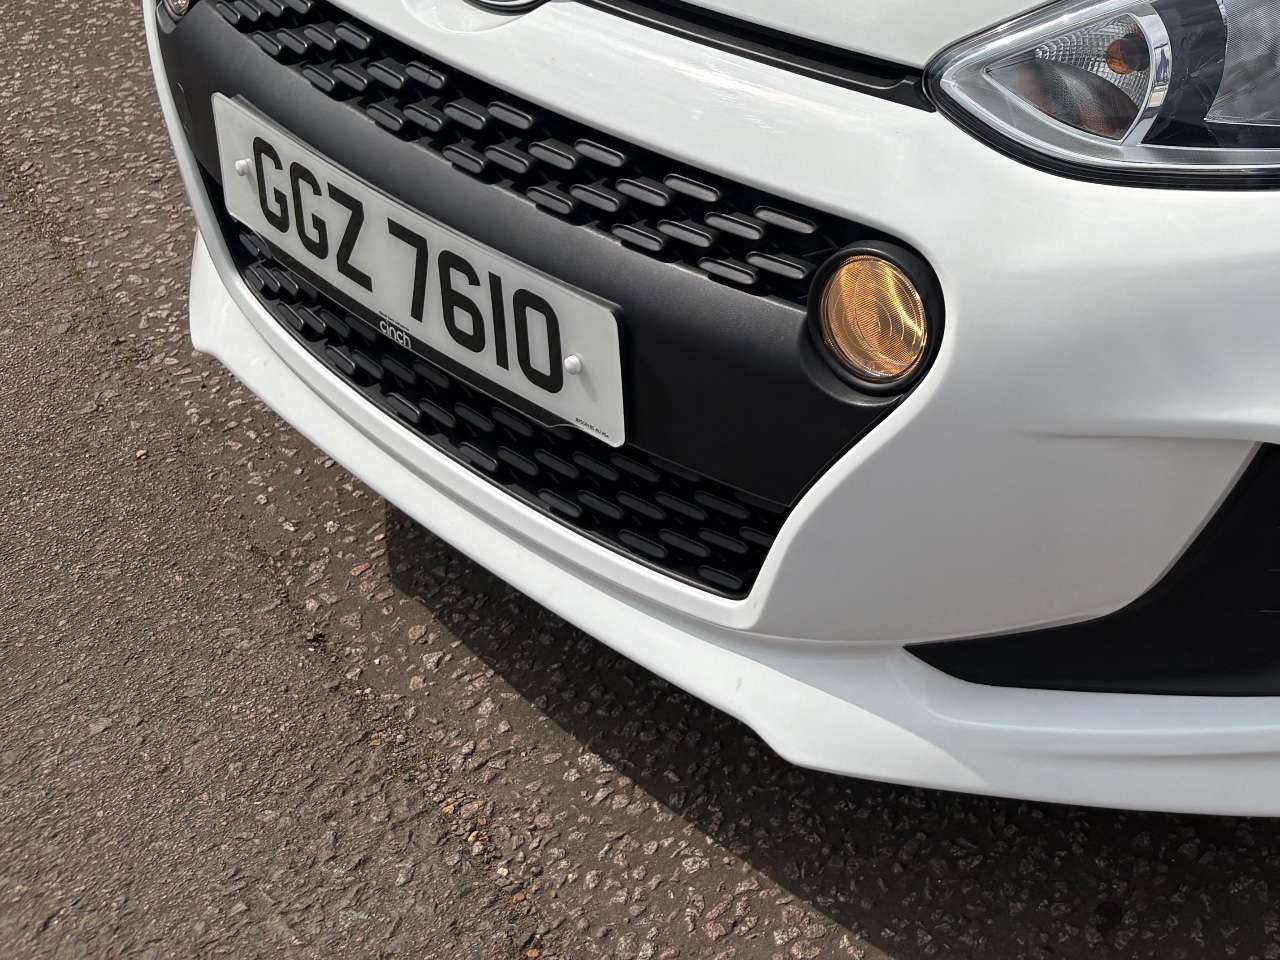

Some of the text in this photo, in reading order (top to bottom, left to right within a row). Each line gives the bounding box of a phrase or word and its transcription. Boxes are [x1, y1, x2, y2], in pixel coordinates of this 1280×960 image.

[252, 136, 564, 394] GGZ 7610
[379, 318, 412, 350] cinch
